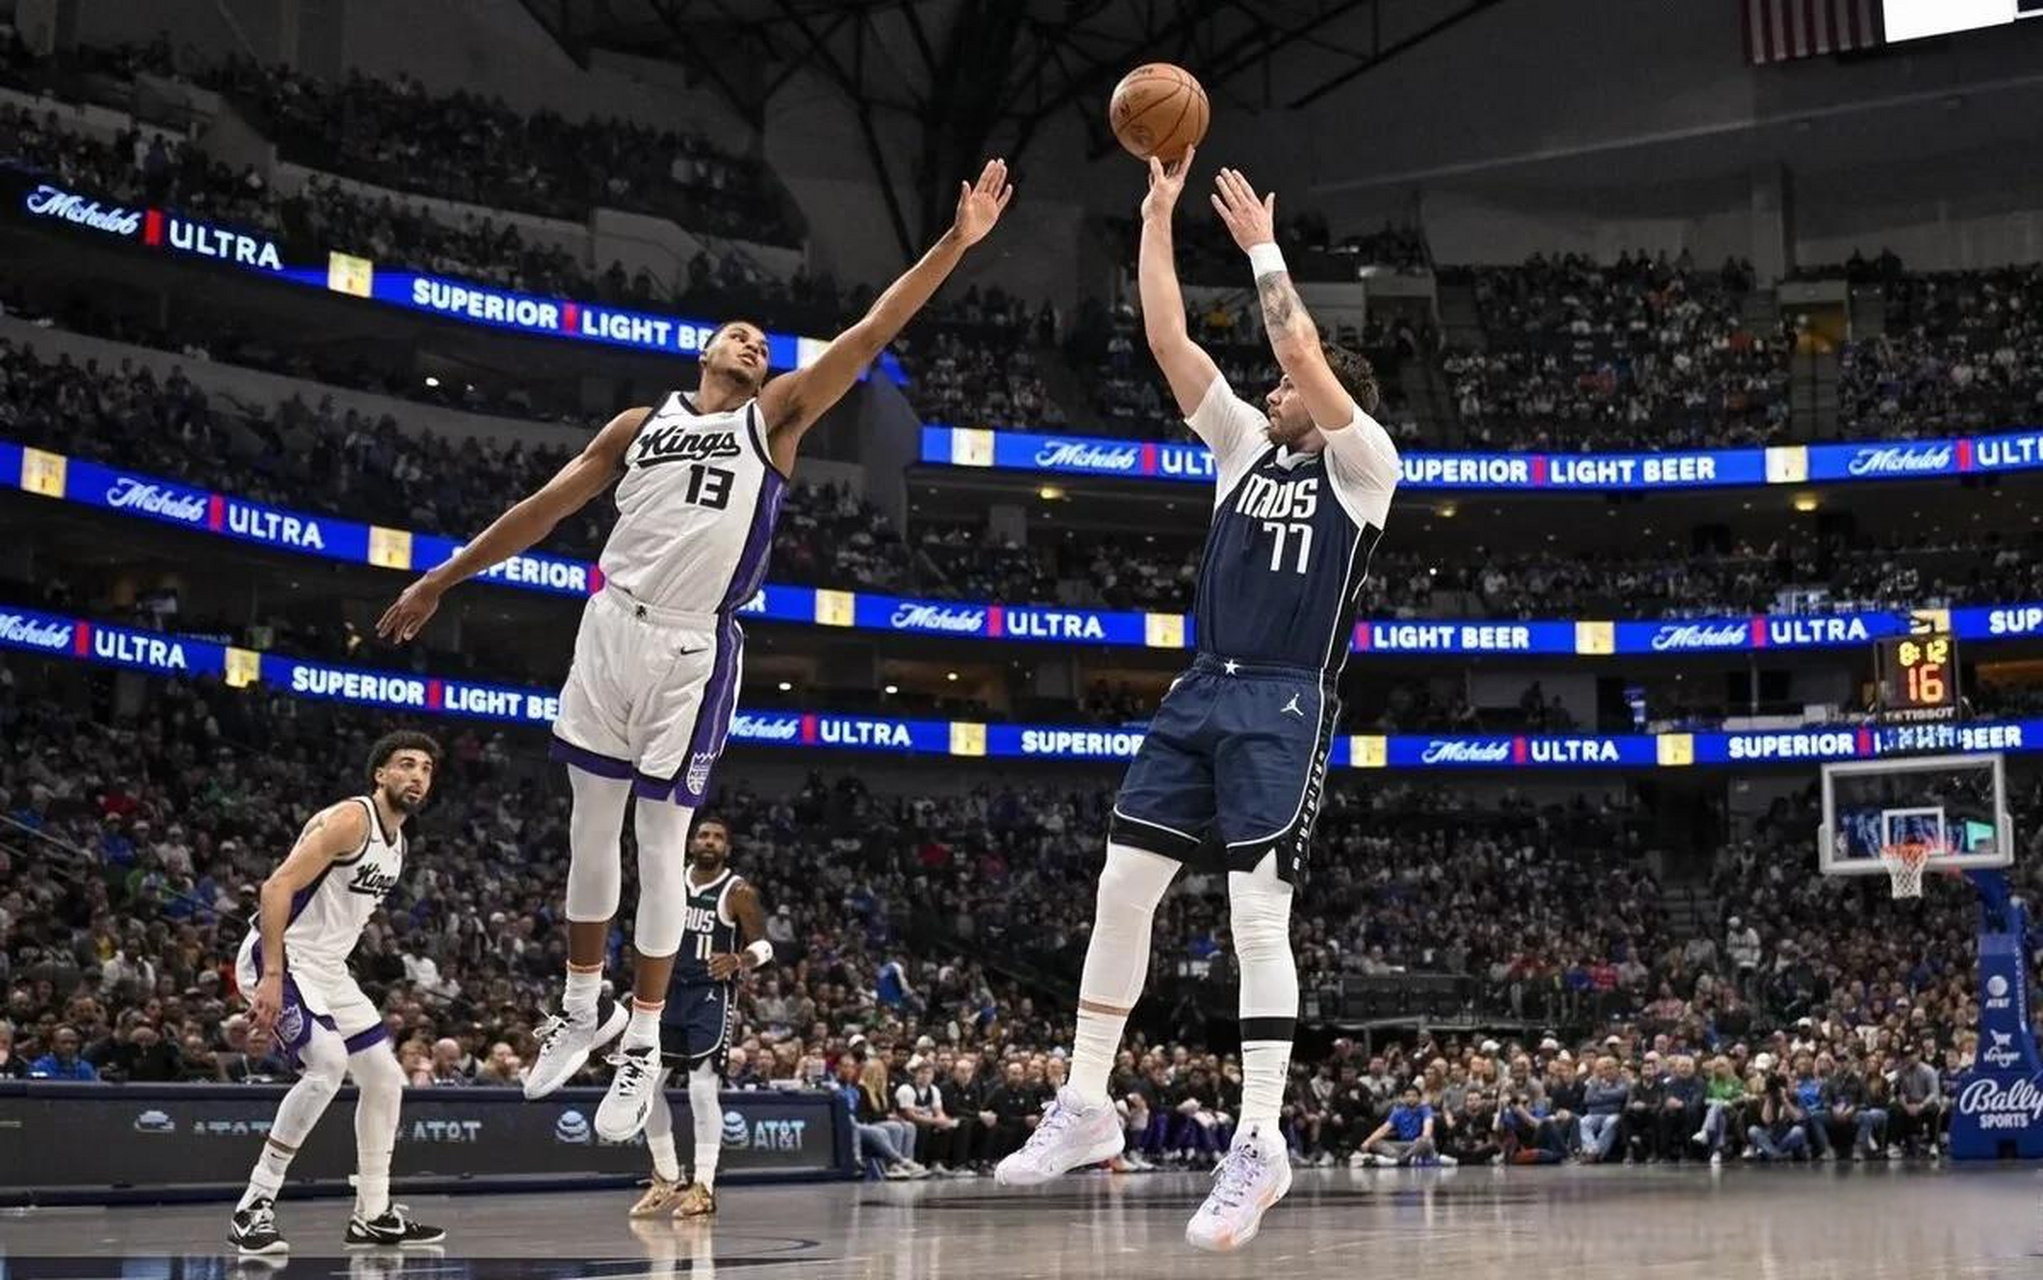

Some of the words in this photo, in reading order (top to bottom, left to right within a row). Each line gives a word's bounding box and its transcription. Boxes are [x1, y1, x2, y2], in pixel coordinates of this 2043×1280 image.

[27, 186, 140, 235] Michelob
[170, 220, 282, 270] ULTRA
[413, 278, 558, 329] SUPERIOR
[582, 309, 671, 346] LIGHT
[637, 425, 741, 468] Kings
[1036, 441, 1137, 469] Michelob
[1162, 453, 1215, 476] ULT
[1849, 446, 1952, 475] Michelob
[1978, 436, 2043, 466] ULT
[685, 463, 735, 511] 13
[1550, 458, 1636, 483] LIGHT
[1643, 456, 1716, 483] BEER
[107, 478, 207, 522] Michelob
[229, 504, 325, 550] ULTRA
[1263, 521, 1313, 575] 77
[891, 604, 984, 631] Michelob
[1008, 613, 1105, 639] ULTRA
[1374, 626, 1455, 649] LIGHT
[1461, 626, 1530, 649] BEER
[1652, 625, 1747, 651] Michelob
[1771, 618, 1869, 645] ULTRA
[95, 630, 188, 668] ULTRA
[1899, 640, 1948, 666] 8:12
[292, 666, 424, 705] SUPERIOR
[445, 686, 522, 717] LIGHT
[527, 696, 559, 721] BE
[1908, 664, 1943, 703] 16
[820, 720, 912, 746] ULTRA
[1729, 733, 1854, 759] SUPERIOR
[1422, 741, 1510, 763] Michelob
[1532, 739, 1620, 762] ULTRA
[695, 933, 712, 960] 11
[1959, 1079, 2043, 1120] Bally
[754, 1121, 805, 1149] AT&T
[1979, 1113, 2029, 1129] SPORTS
